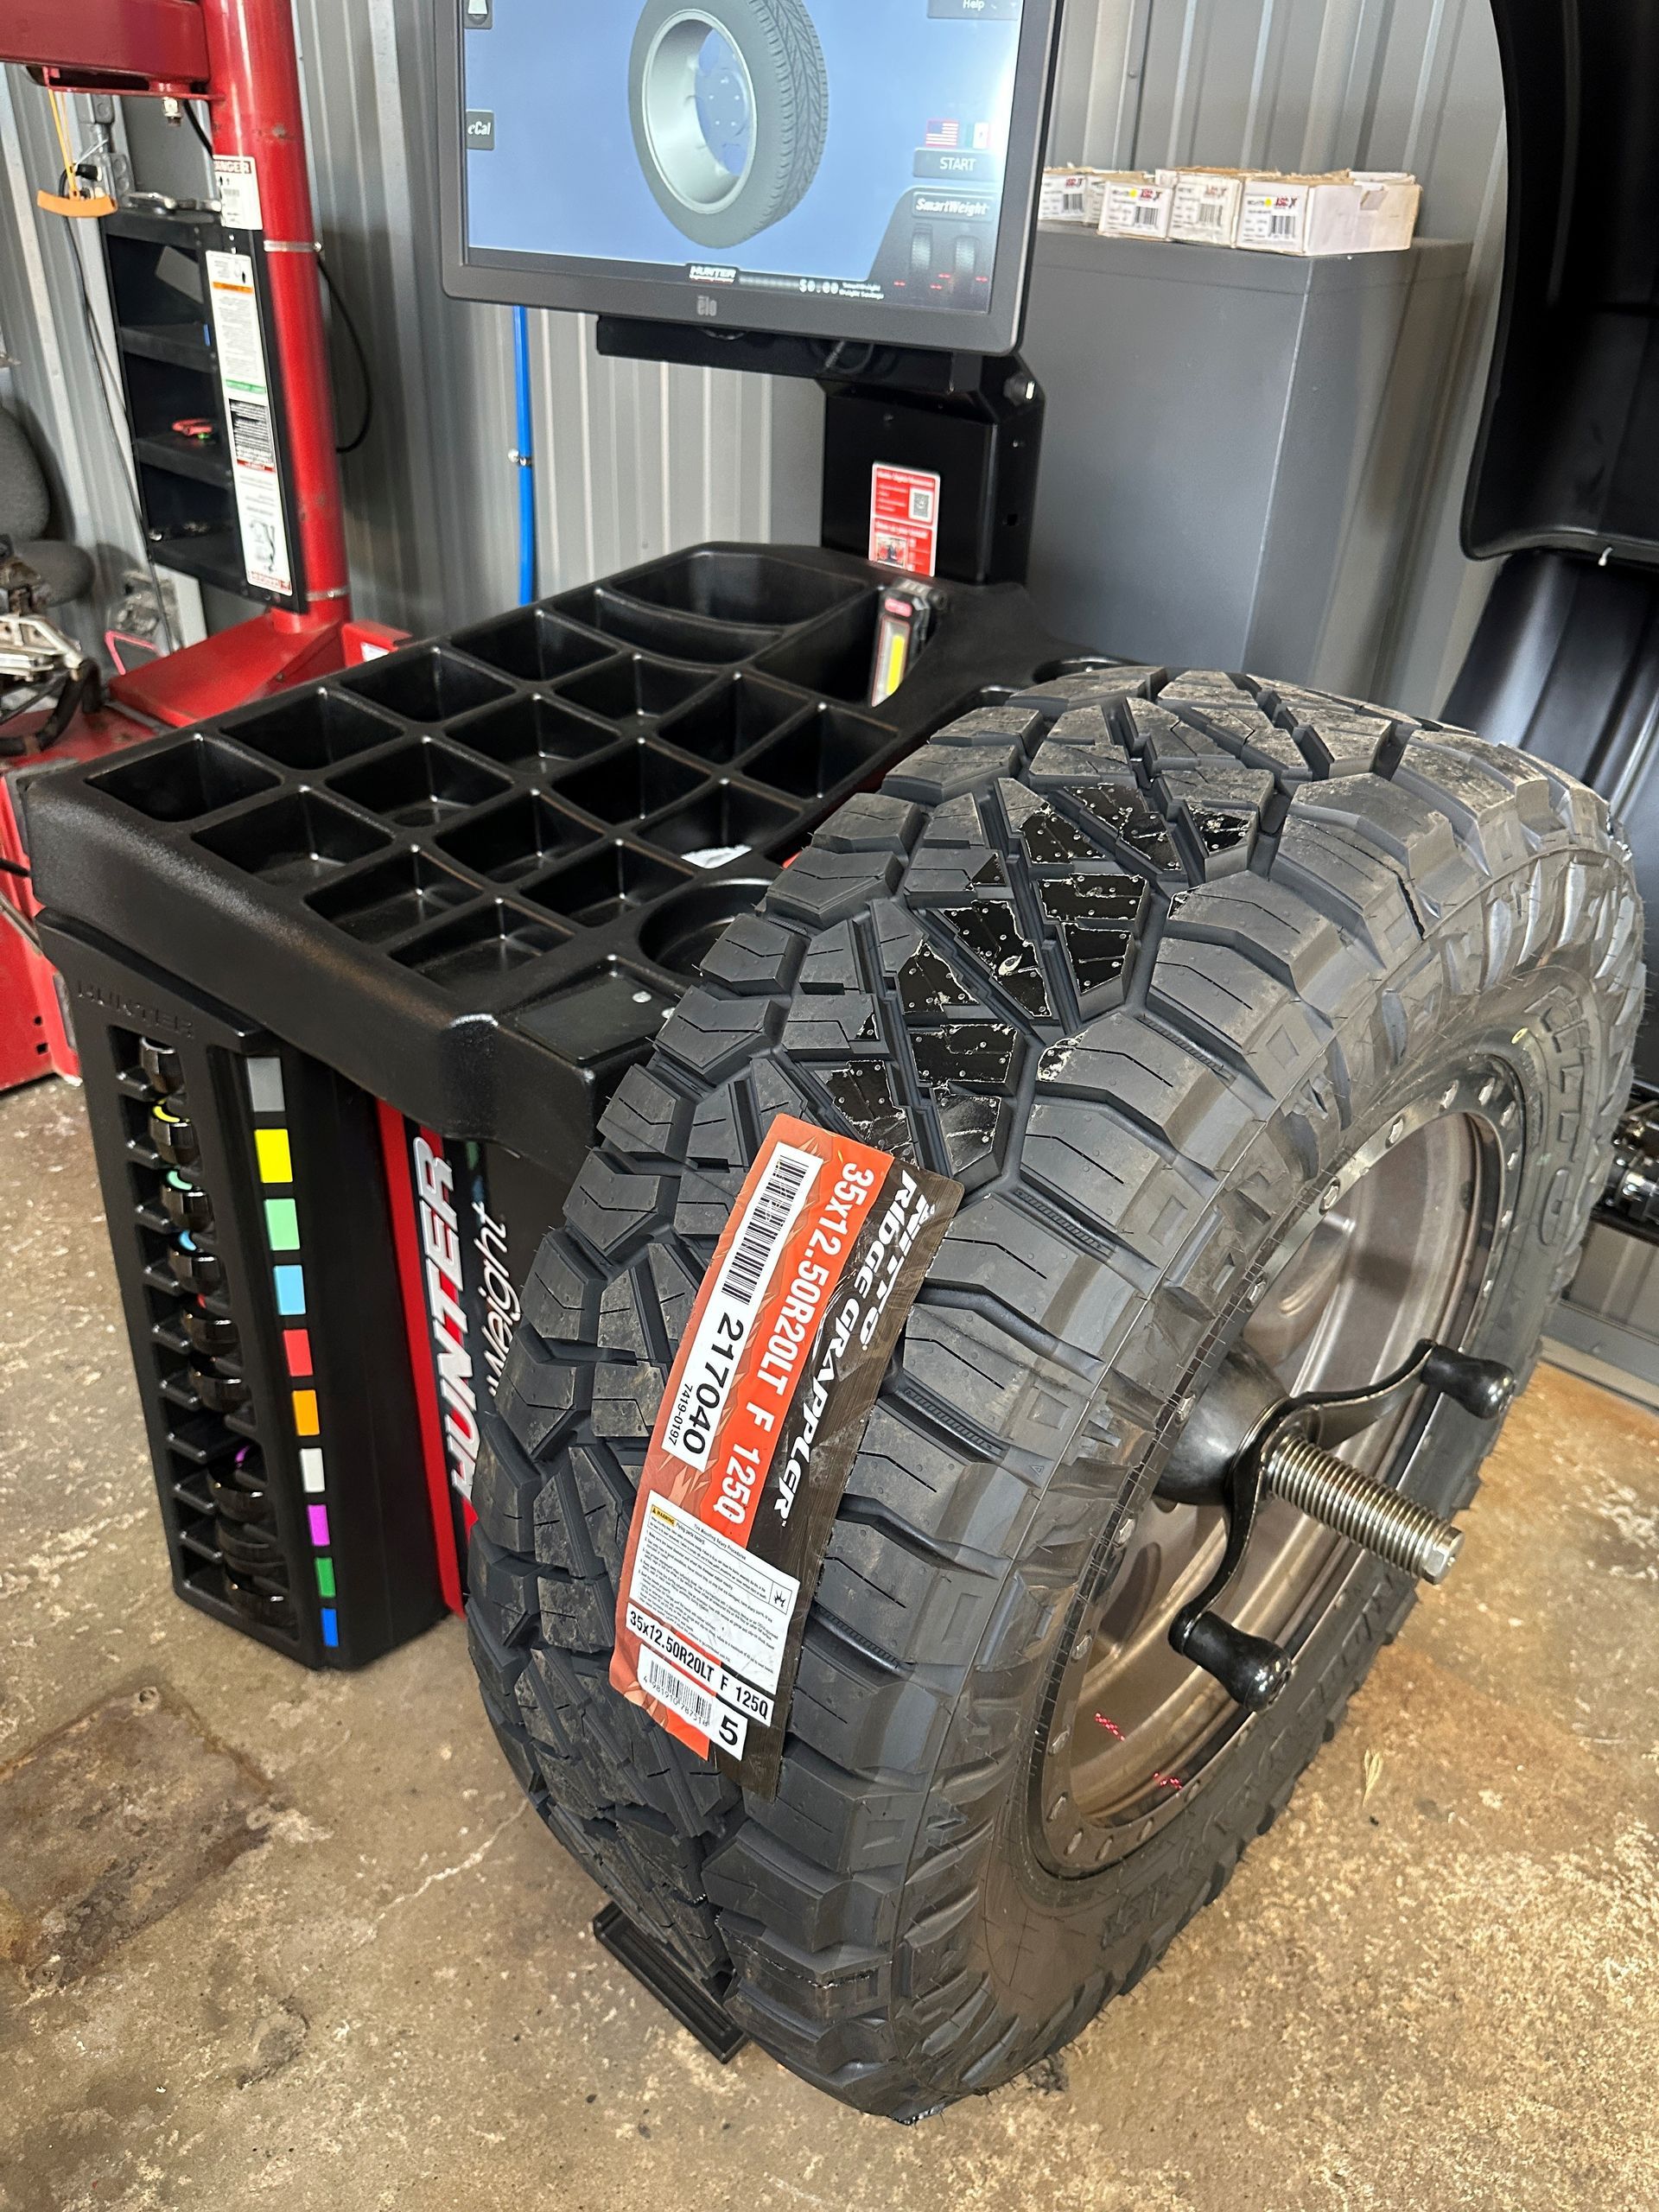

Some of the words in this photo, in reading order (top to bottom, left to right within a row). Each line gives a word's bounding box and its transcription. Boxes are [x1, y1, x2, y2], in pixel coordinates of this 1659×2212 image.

[963, 0, 985, 10] Help
[467, 121, 491, 136] eCal
[939, 156, 976, 171] START
[916, 197, 988, 217] SmartWeight
[690, 265, 736, 278] HUNTER
[854, 1170, 918, 1297] RIDGE
[758, 1161, 874, 1395] 35x12.50R20LT
[413, 1136, 480, 1500] HUNTER
[670, 1382, 693, 1446] 7419-0197
[683, 1313, 743, 1455] 217040
[776, 1300, 861, 1520] GRAPPLER
[746, 1401, 774, 1432] F
[713, 1444, 760, 1524] 125Q
[630, 1611, 715, 1682] 35x12.50R20LT
[720, 1676, 728, 1692] F
[736, 1686, 768, 1719] 125Q
[719, 1713, 739, 1745] 5
